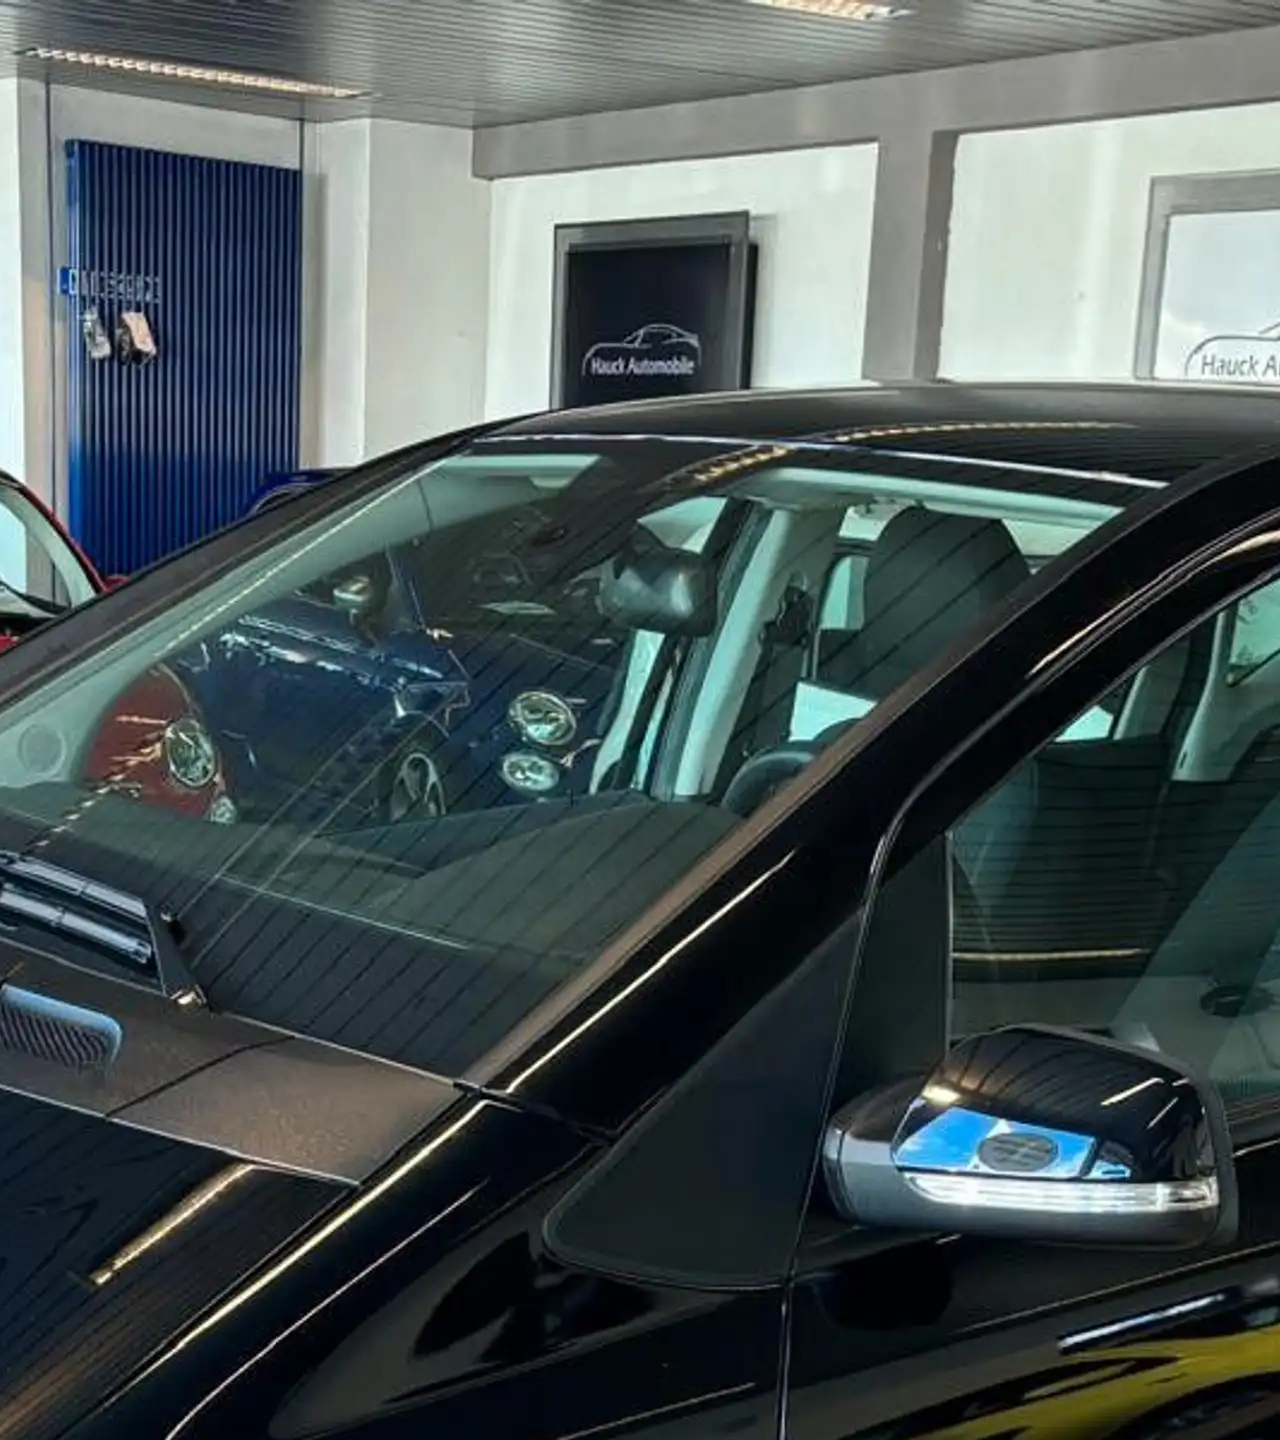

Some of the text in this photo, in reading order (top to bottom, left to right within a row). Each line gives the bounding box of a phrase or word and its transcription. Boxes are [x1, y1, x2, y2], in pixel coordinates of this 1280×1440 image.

[591, 355, 696, 375] Hauck Automobile
[1201, 354, 1259, 376] Hauck
